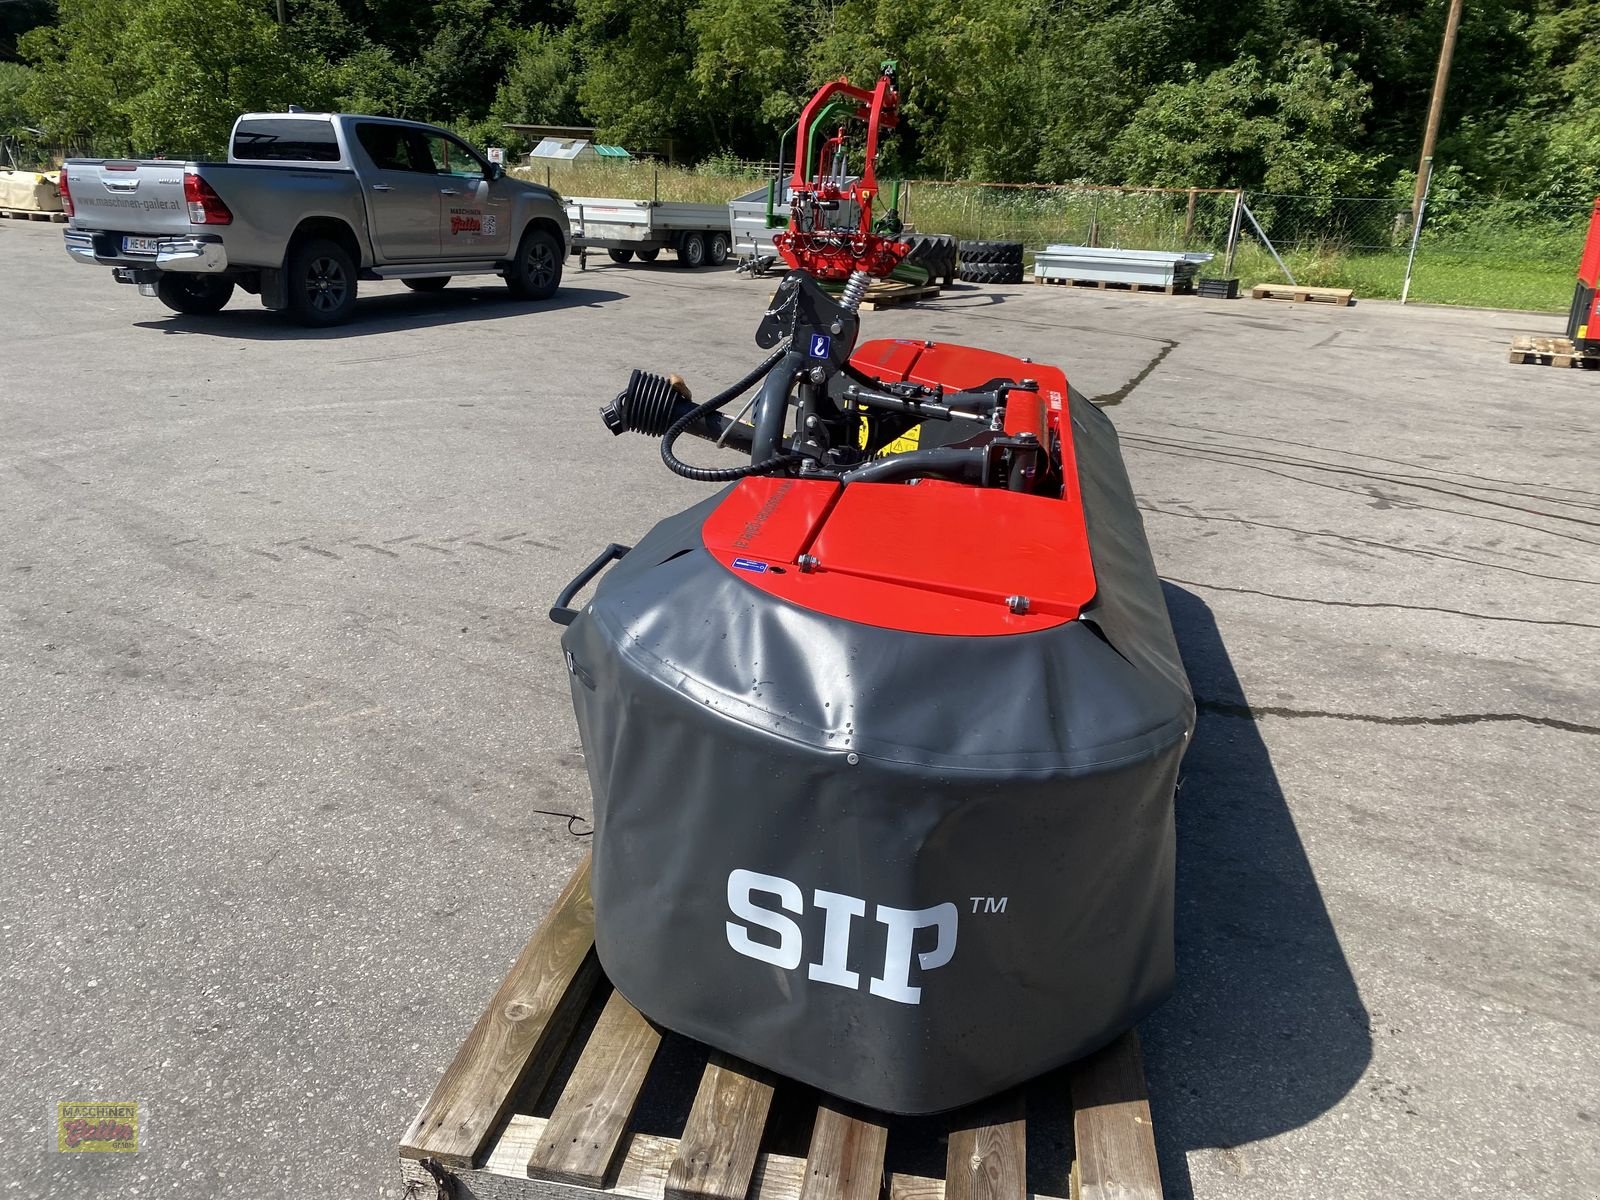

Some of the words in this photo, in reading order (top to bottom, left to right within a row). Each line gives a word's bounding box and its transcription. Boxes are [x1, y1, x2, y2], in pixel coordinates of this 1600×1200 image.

[77, 196, 181, 211] www.maschinen-gailer.at
[130, 238, 139, 249] HE
[726, 868, 959, 1005] SIP
[969, 897, 1008, 914] TM
